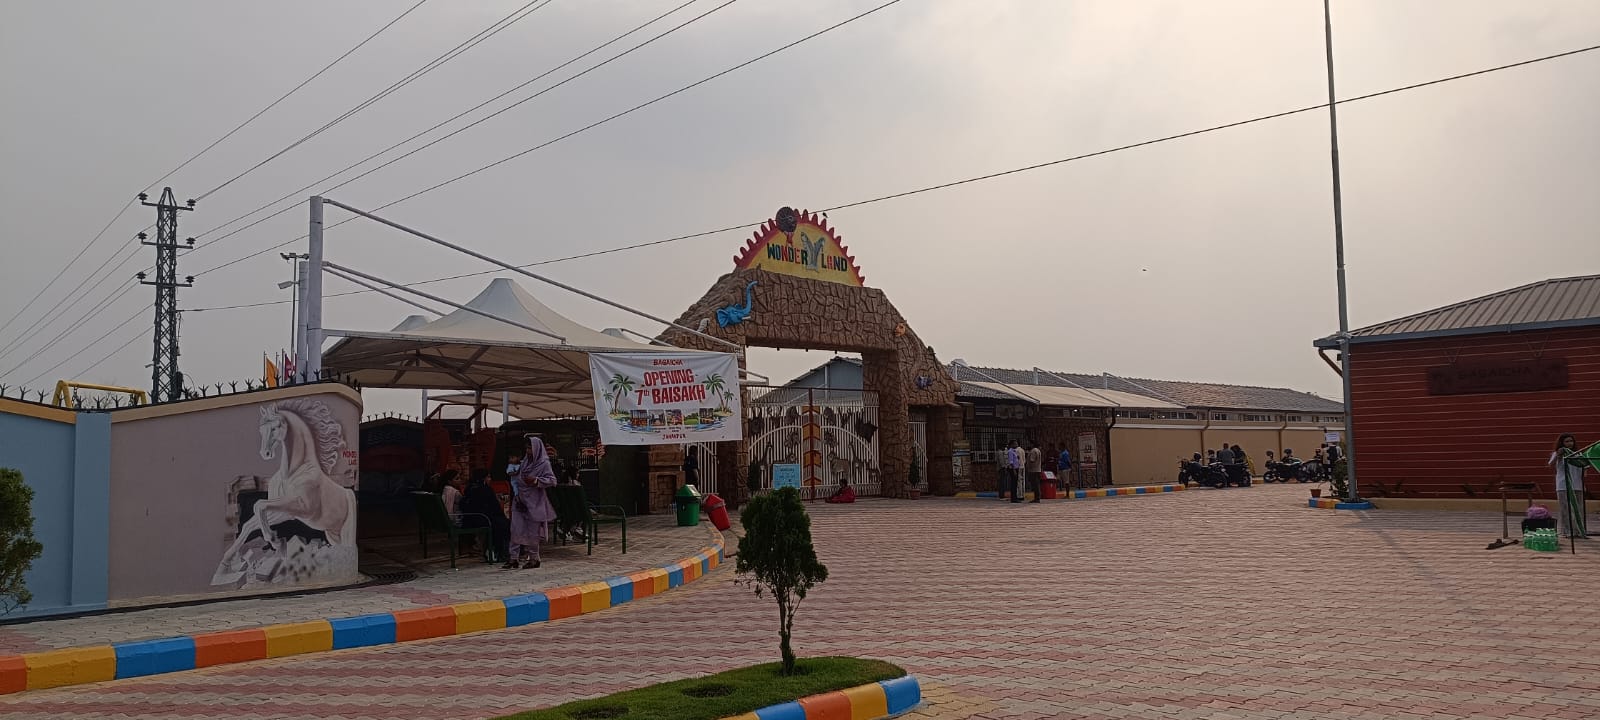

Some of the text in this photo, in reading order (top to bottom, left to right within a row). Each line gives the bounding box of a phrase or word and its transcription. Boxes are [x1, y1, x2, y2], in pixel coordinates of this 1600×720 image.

[767, 243, 848, 272] WONDER LAND
[644, 369, 694, 386] OPENING
[634, 385, 705, 405] 7th BAISAKH
